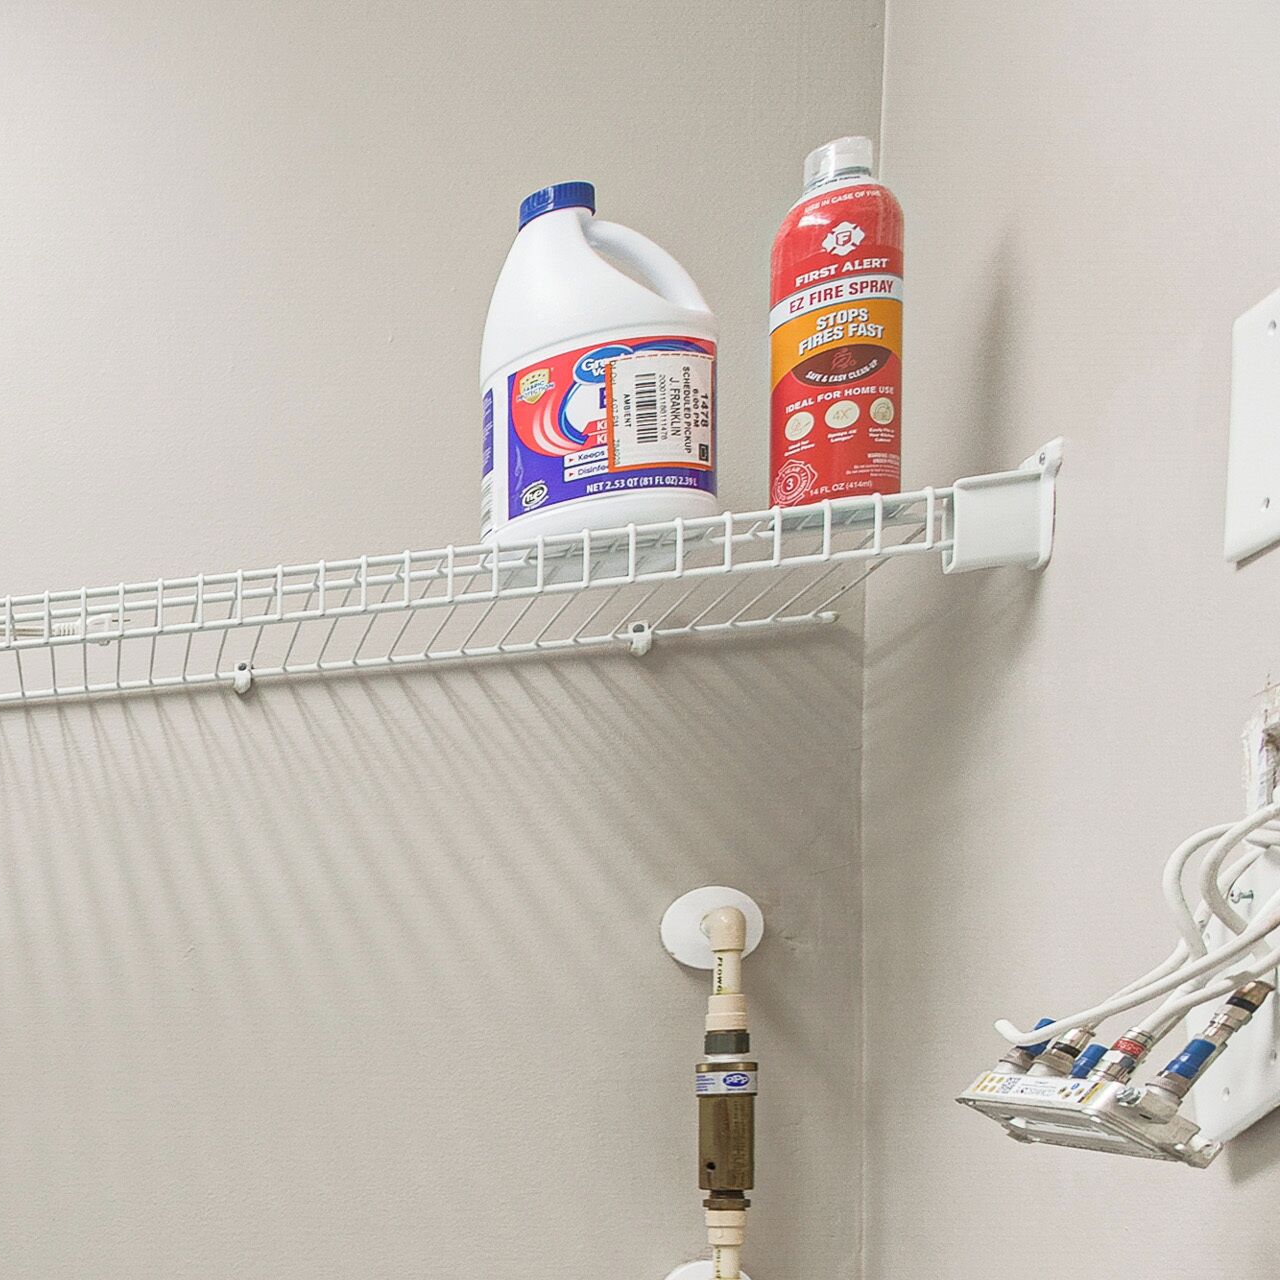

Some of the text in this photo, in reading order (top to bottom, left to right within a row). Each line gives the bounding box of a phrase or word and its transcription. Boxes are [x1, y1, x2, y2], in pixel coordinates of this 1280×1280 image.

[821, 199, 831, 207] IN
[831, 193, 854, 203] CASE
[795, 258, 889, 288] FIRST ALERT
[789, 280, 894, 314] EZ FIRE SPRAY
[816, 308, 869, 331] STOPS
[799, 323, 884, 356] FIRES FAST
[624, 393, 632, 428] AMBIENT
[670, 388, 681, 437] FRANKLIN
[682, 366, 692, 454] SCHEDULED PICKUP
[700, 393, 709, 428] 1478
[785, 386, 894, 414] IDEAL FOR HOME USE
[693, 412, 700, 428] PM
[578, 450, 605, 461] Keeps
[586, 482, 604, 493] NET
[605, 479, 625, 490] 2.53
[626, 477, 639, 487] QT
[640, 477, 653, 487] (81
[655, 476, 665, 485] FL
[786, 478, 794, 490] 3
[820, 486, 831, 494] FL
[832, 483, 845, 492] OZ
